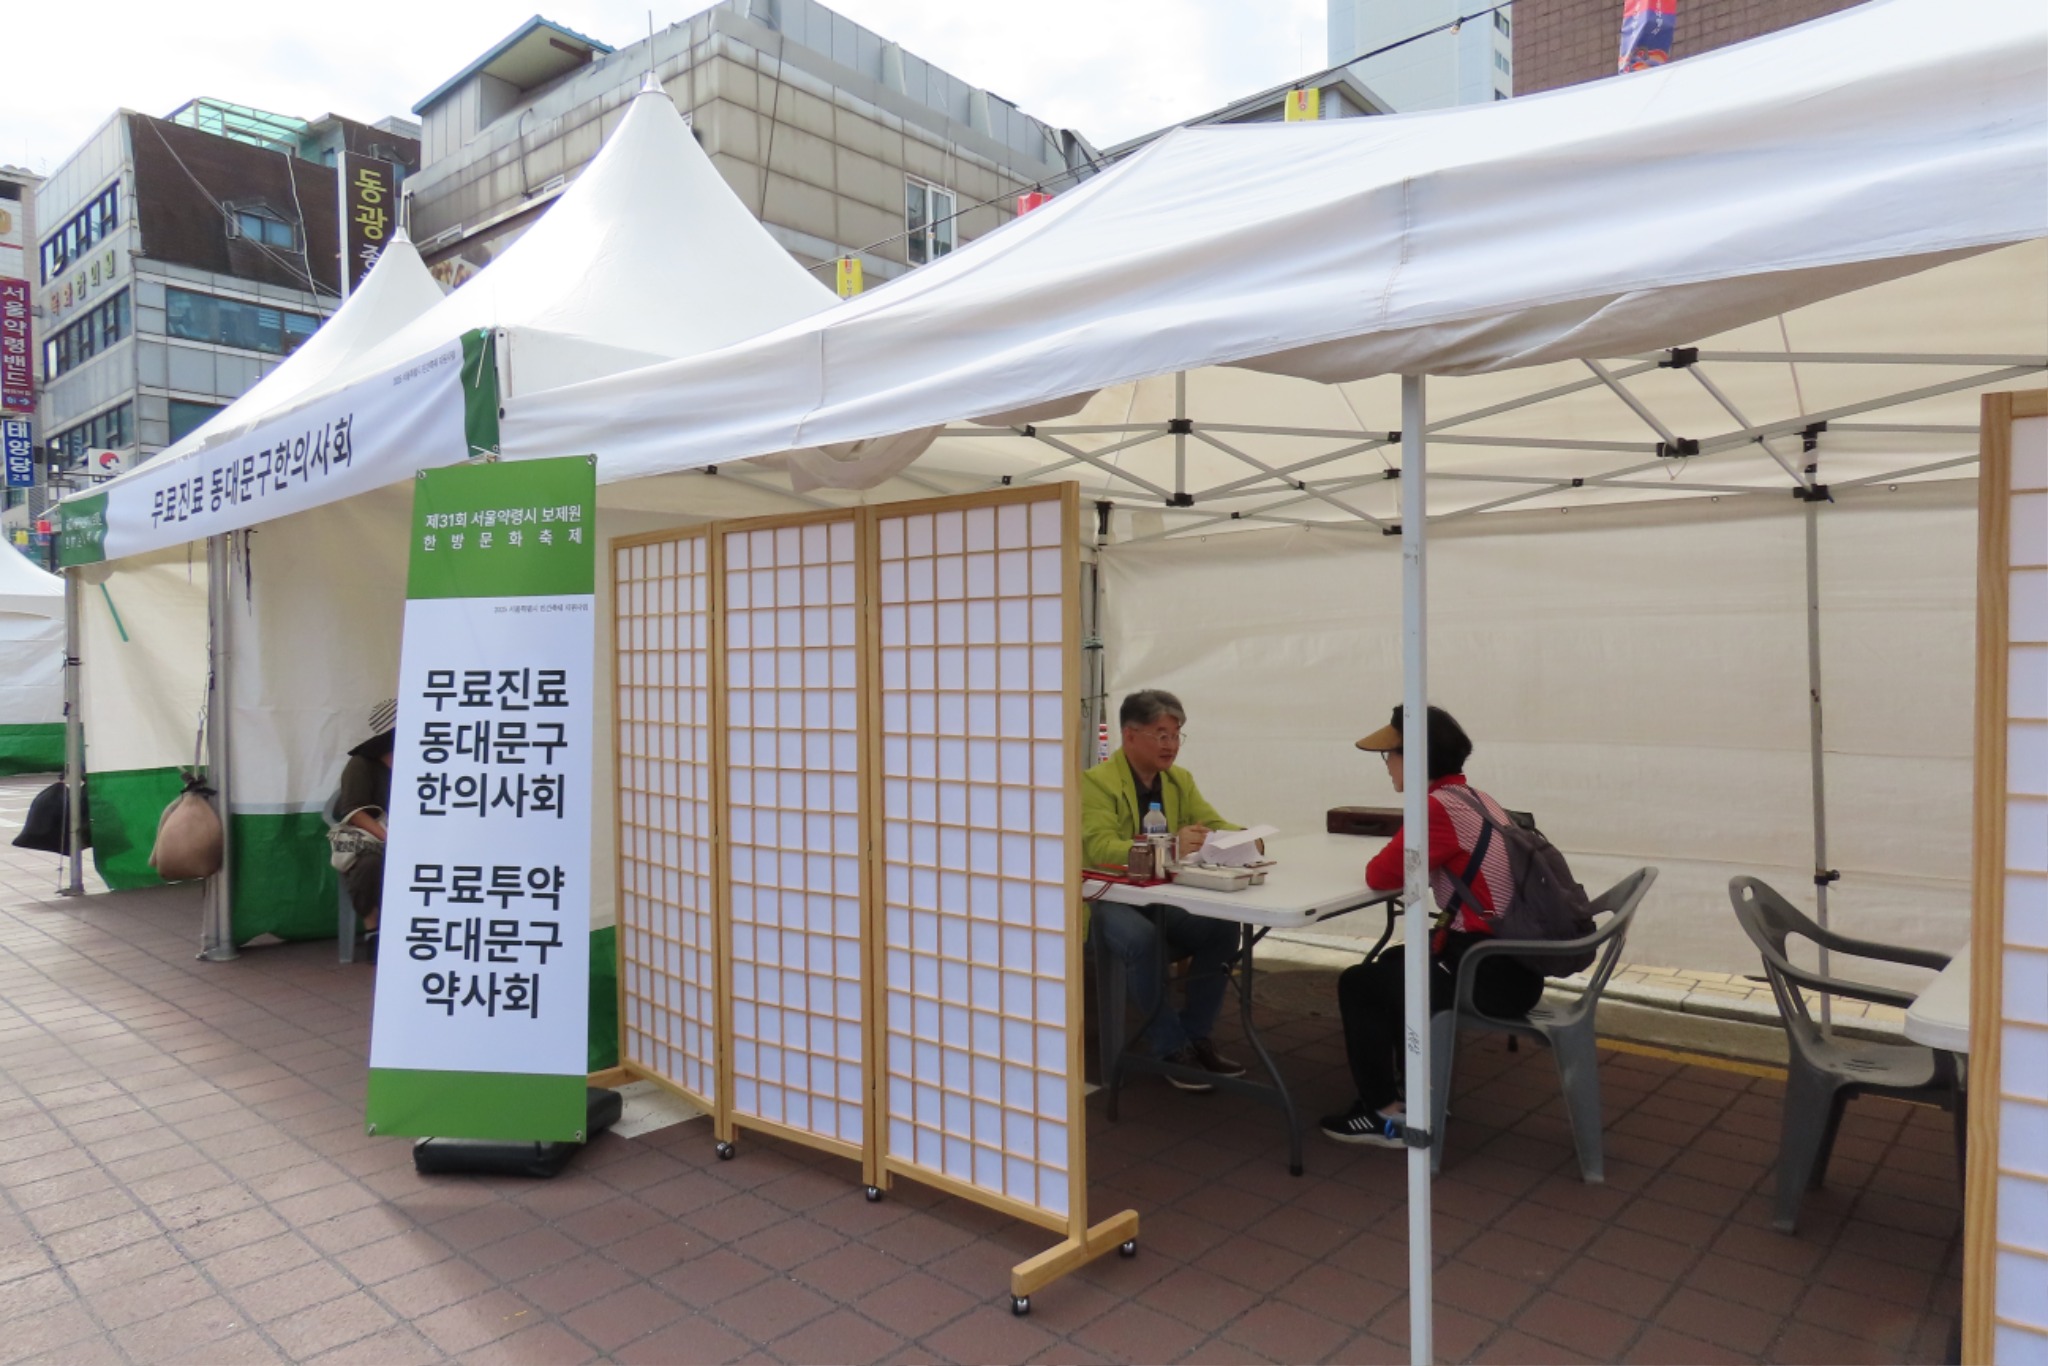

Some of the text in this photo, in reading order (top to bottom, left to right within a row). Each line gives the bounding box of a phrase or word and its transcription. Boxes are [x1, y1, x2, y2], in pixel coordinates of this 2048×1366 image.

[7, 421, 32, 473] 태양당
[151, 413, 353, 529] 무료진료 동대문구한의사회
[425, 504, 581, 530] 제31회 서울약령시 보제원
[422, 667, 569, 712] 무료진료
[419, 720, 568, 766] 동대문구
[416, 772, 565, 819] 한의사회
[409, 864, 565, 911] 무료투약
[405, 917, 563, 965] 동대문구
[421, 970, 540, 1019] 약사회
